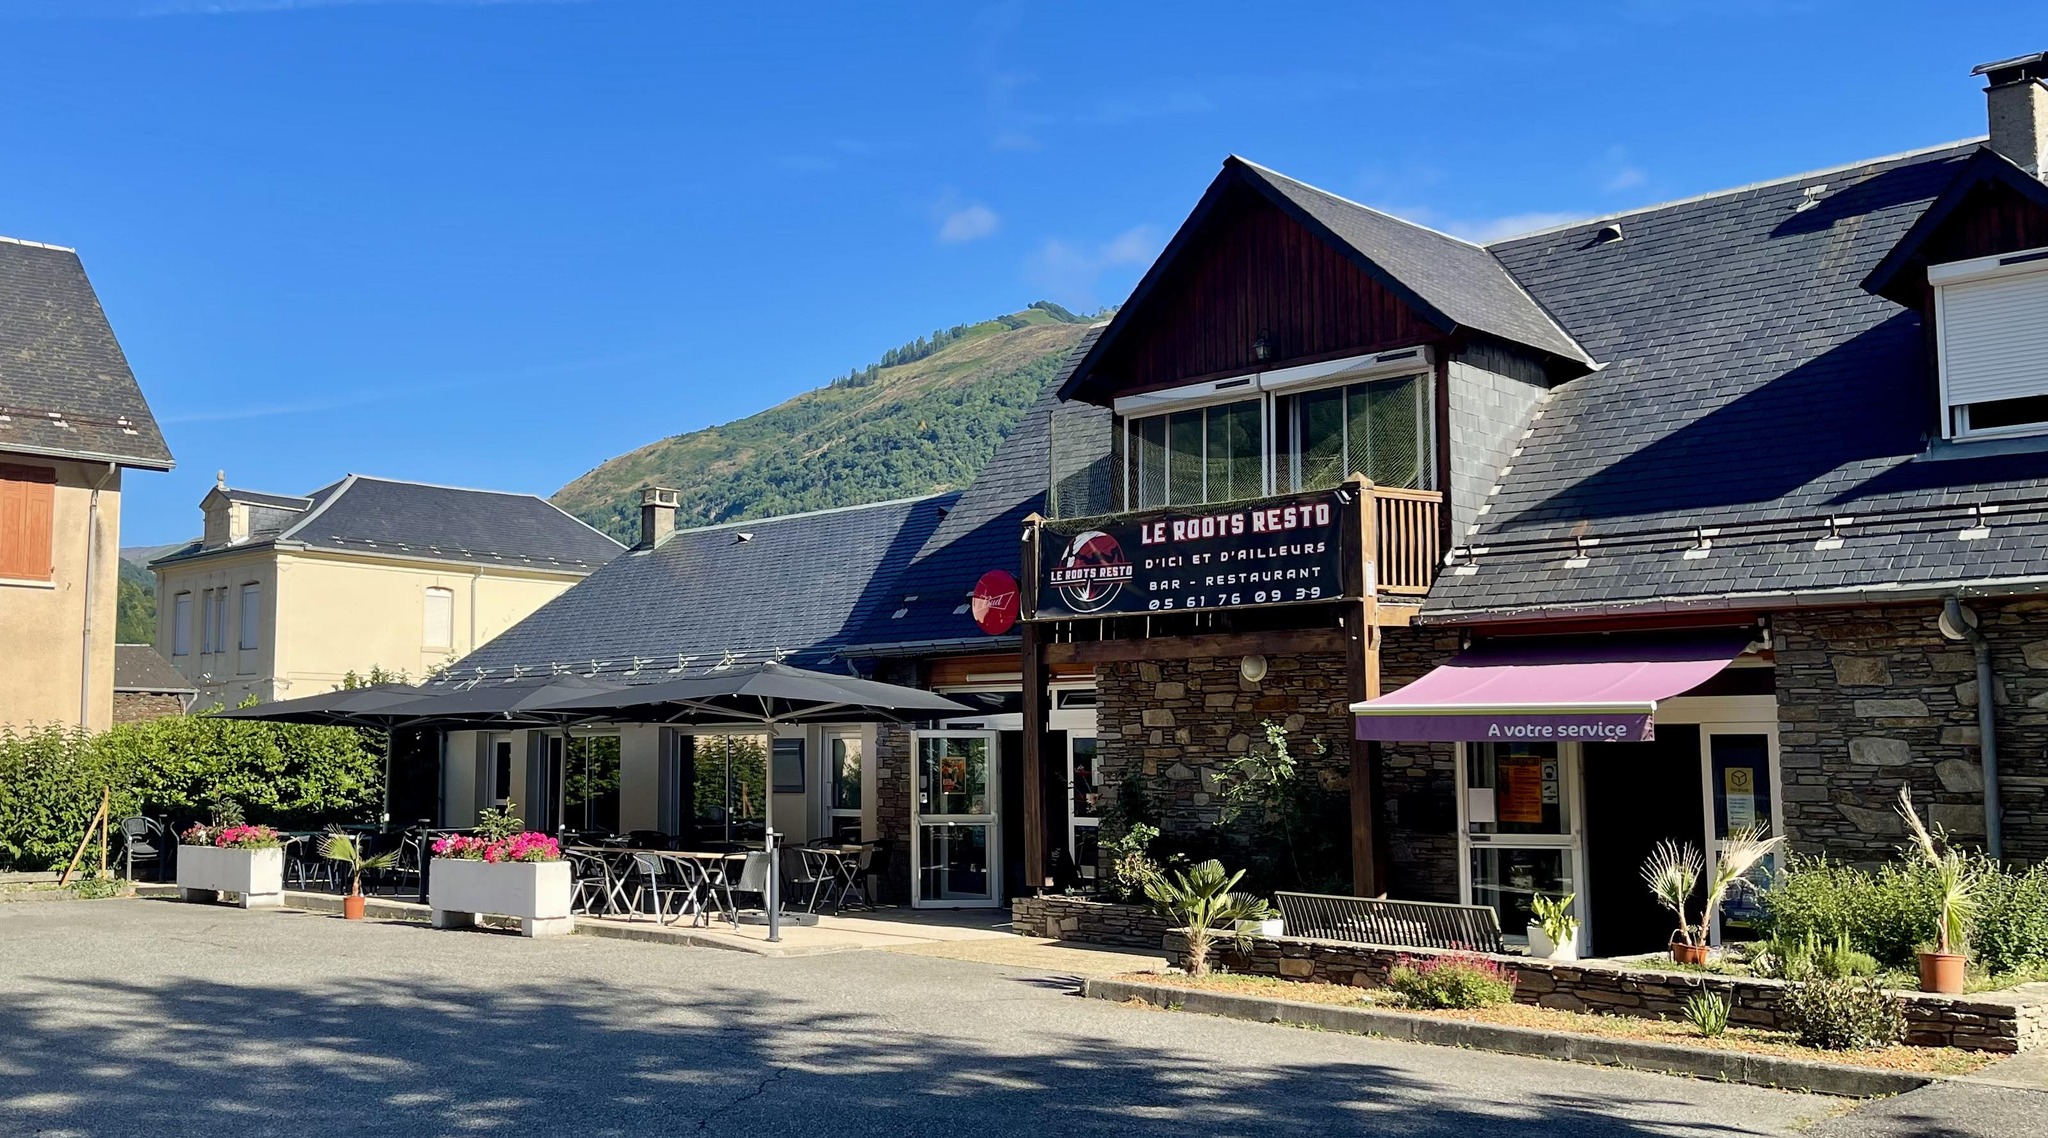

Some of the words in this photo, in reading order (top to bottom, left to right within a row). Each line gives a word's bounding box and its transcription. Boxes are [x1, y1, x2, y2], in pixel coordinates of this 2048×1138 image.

[1142, 522, 1166, 545] LE
[1173, 513, 1245, 542] ROOTS
[1252, 503, 1330, 533] RESTO
[1145, 556, 1183, 569] D'ICI
[1192, 553, 1211, 565] ET
[1220, 542, 1326, 562] D'AILLEURS
[1050, 571, 1063, 582] LE
[1065, 568, 1097, 580] ROOTS
[1100, 565, 1133, 577] RESTO
[1149, 579, 1181, 591] BAR
[1205, 567, 1321, 587] RESTAURANT
[1148, 598, 1174, 610] 05
[1186, 596, 1205, 608] 61
[1218, 593, 1241, 606] 76
[1254, 590, 1282, 603] 09
[1296, 586, 1321, 600] 39
[1488, 723, 1501, 737] A
[1504, 724, 1552, 737] votre
[1557, 721, 1627, 737] service
